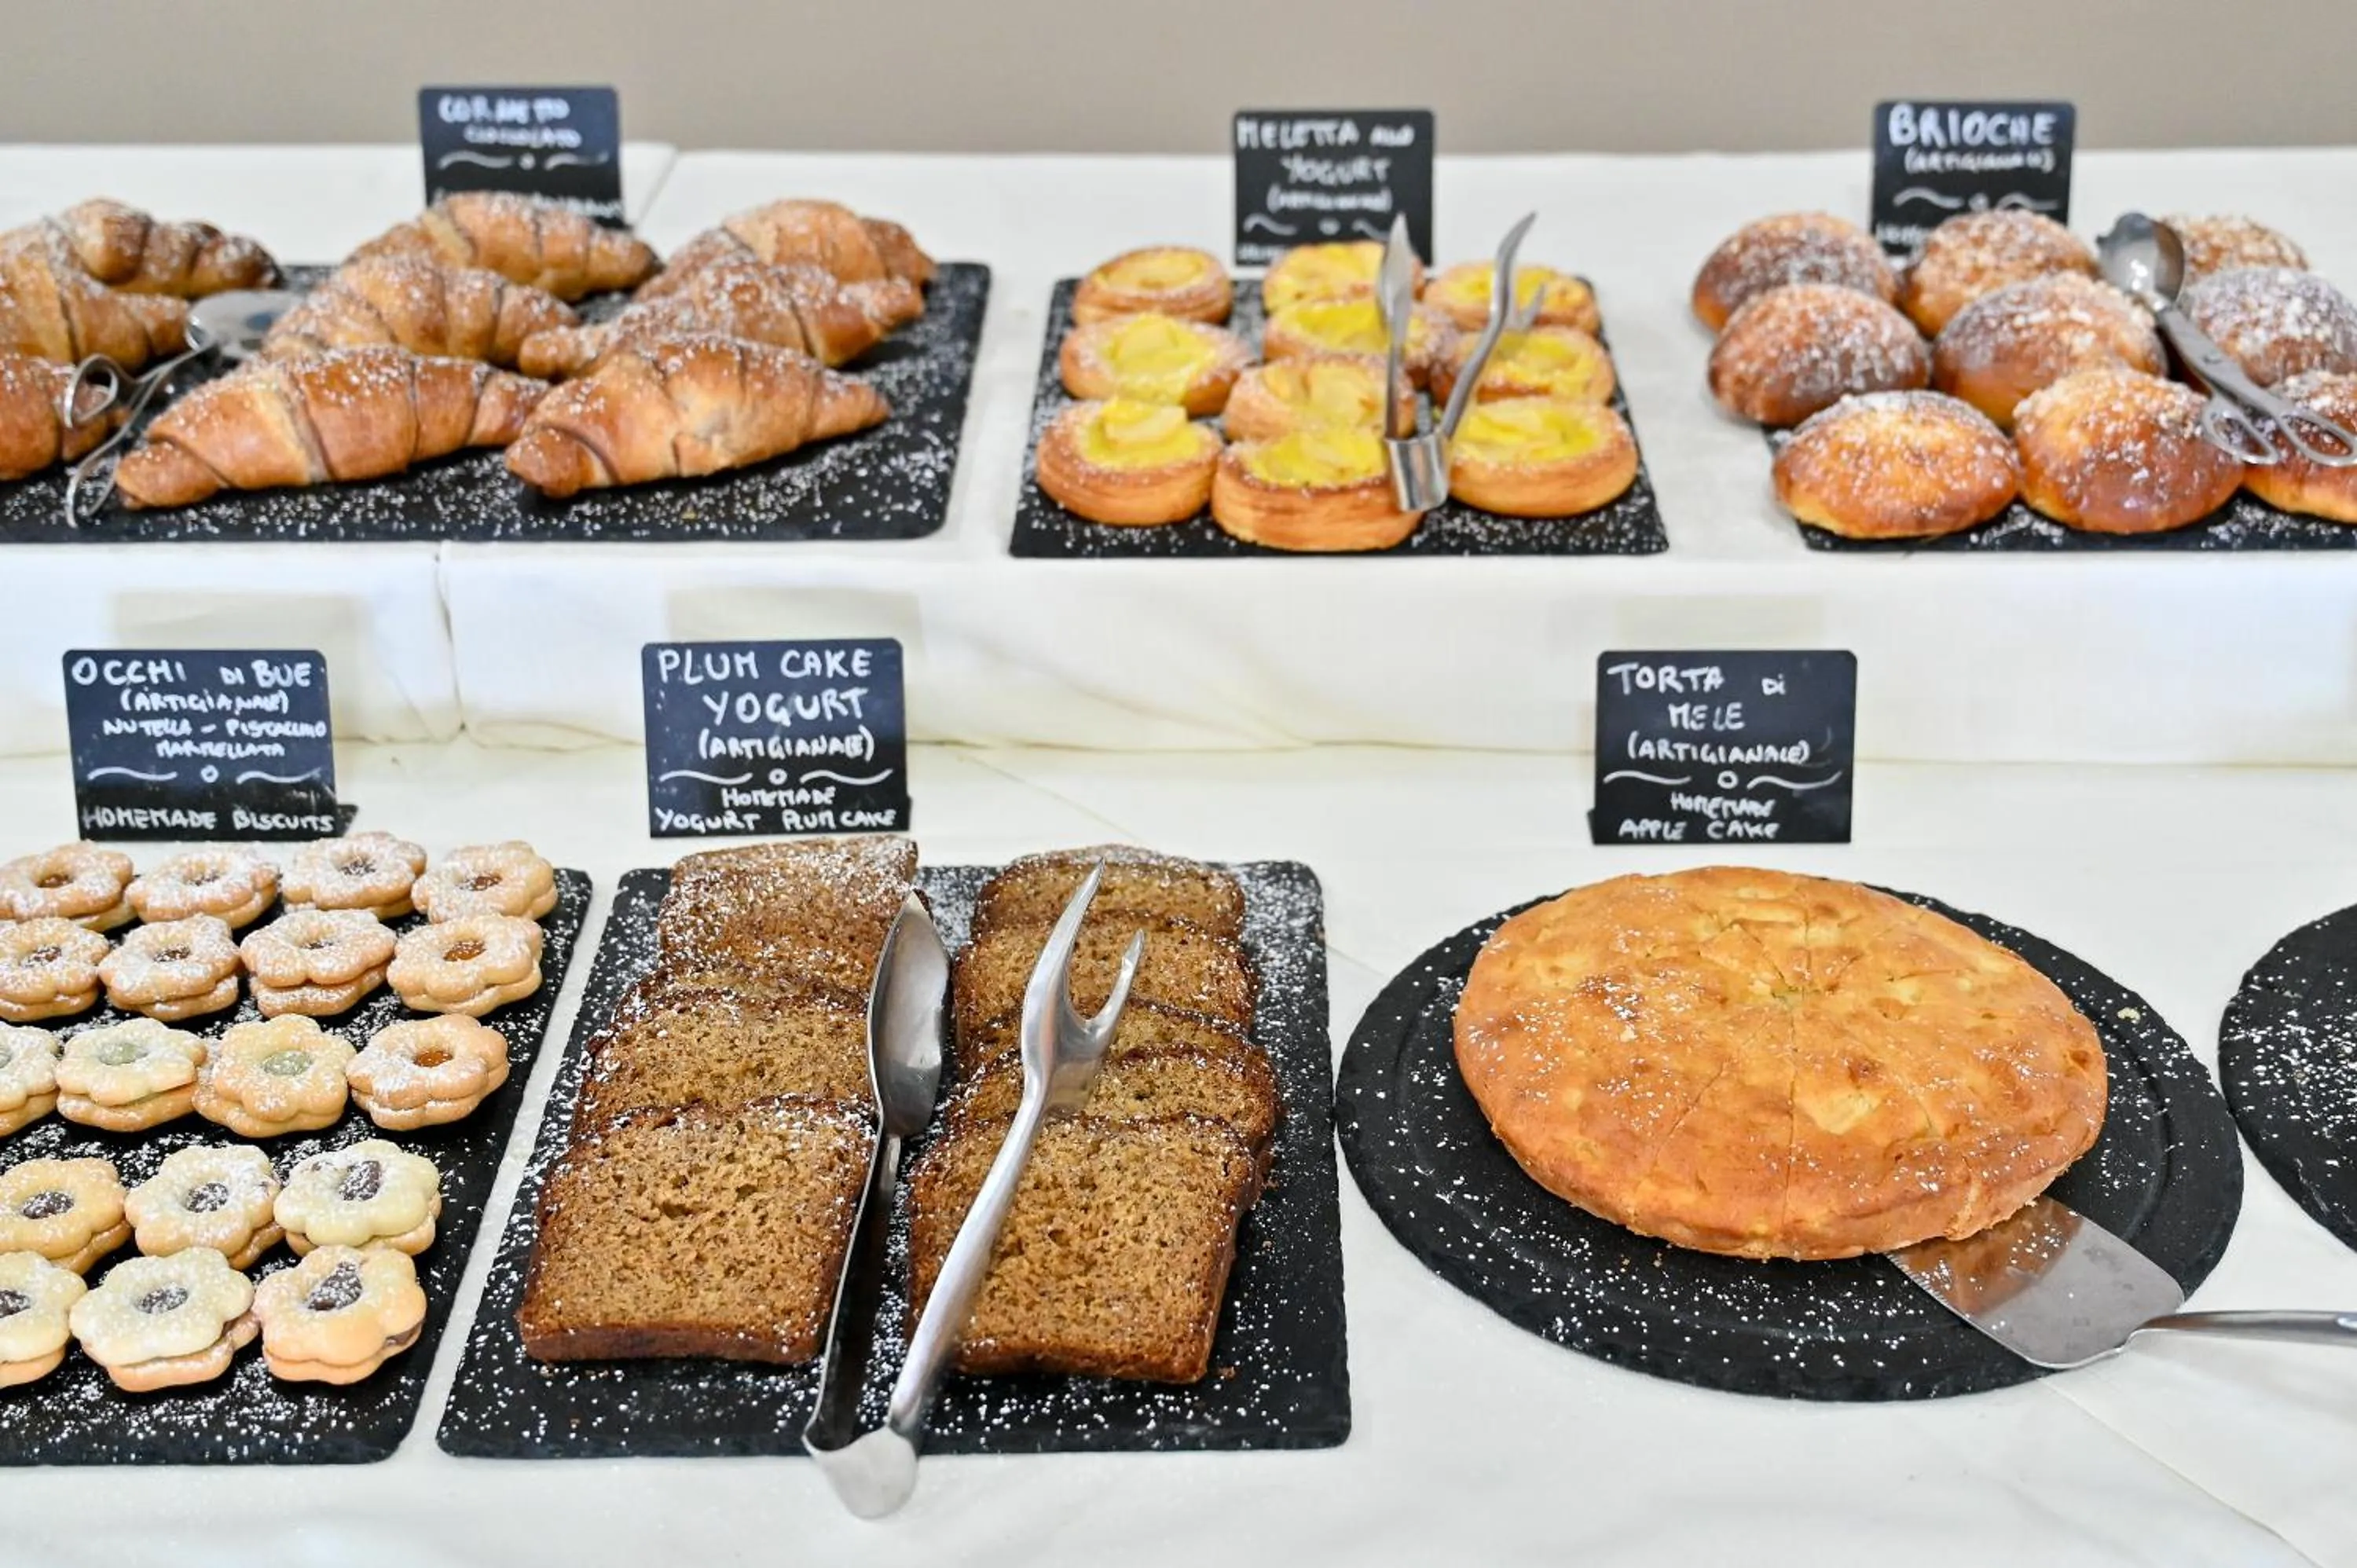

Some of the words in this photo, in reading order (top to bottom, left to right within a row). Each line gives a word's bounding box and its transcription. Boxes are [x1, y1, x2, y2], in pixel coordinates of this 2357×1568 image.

[1889, 102, 2057, 148] BRIOCHE
[1279, 152, 1392, 186] YOGURT
[71, 657, 187, 686] OCCHI
[219, 666, 246, 685] DI
[251, 659, 312, 688] BUE
[658, 649, 759, 685] PLUM
[780, 649, 874, 679] CAKE
[1607, 662, 1725, 695] TORTA
[702, 687, 868, 727] YOGURT
[1668, 702, 1746, 731] MELE
[102, 718, 192, 736] NUTELLA
[155, 741, 286, 760] MARMELLATA
[698, 724, 875, 763] (ARTIGIANALE)
[1628, 730, 1810, 765] (ARTIGIANALE)
[81, 803, 218, 830] HOMEMADE
[232, 805, 335, 832] BISCUITS
[654, 806, 762, 834] YOGURT
[839, 808, 898, 828] CAKE
[1618, 819, 1688, 841] APPLE
[1706, 819, 1780, 839] CAKE
